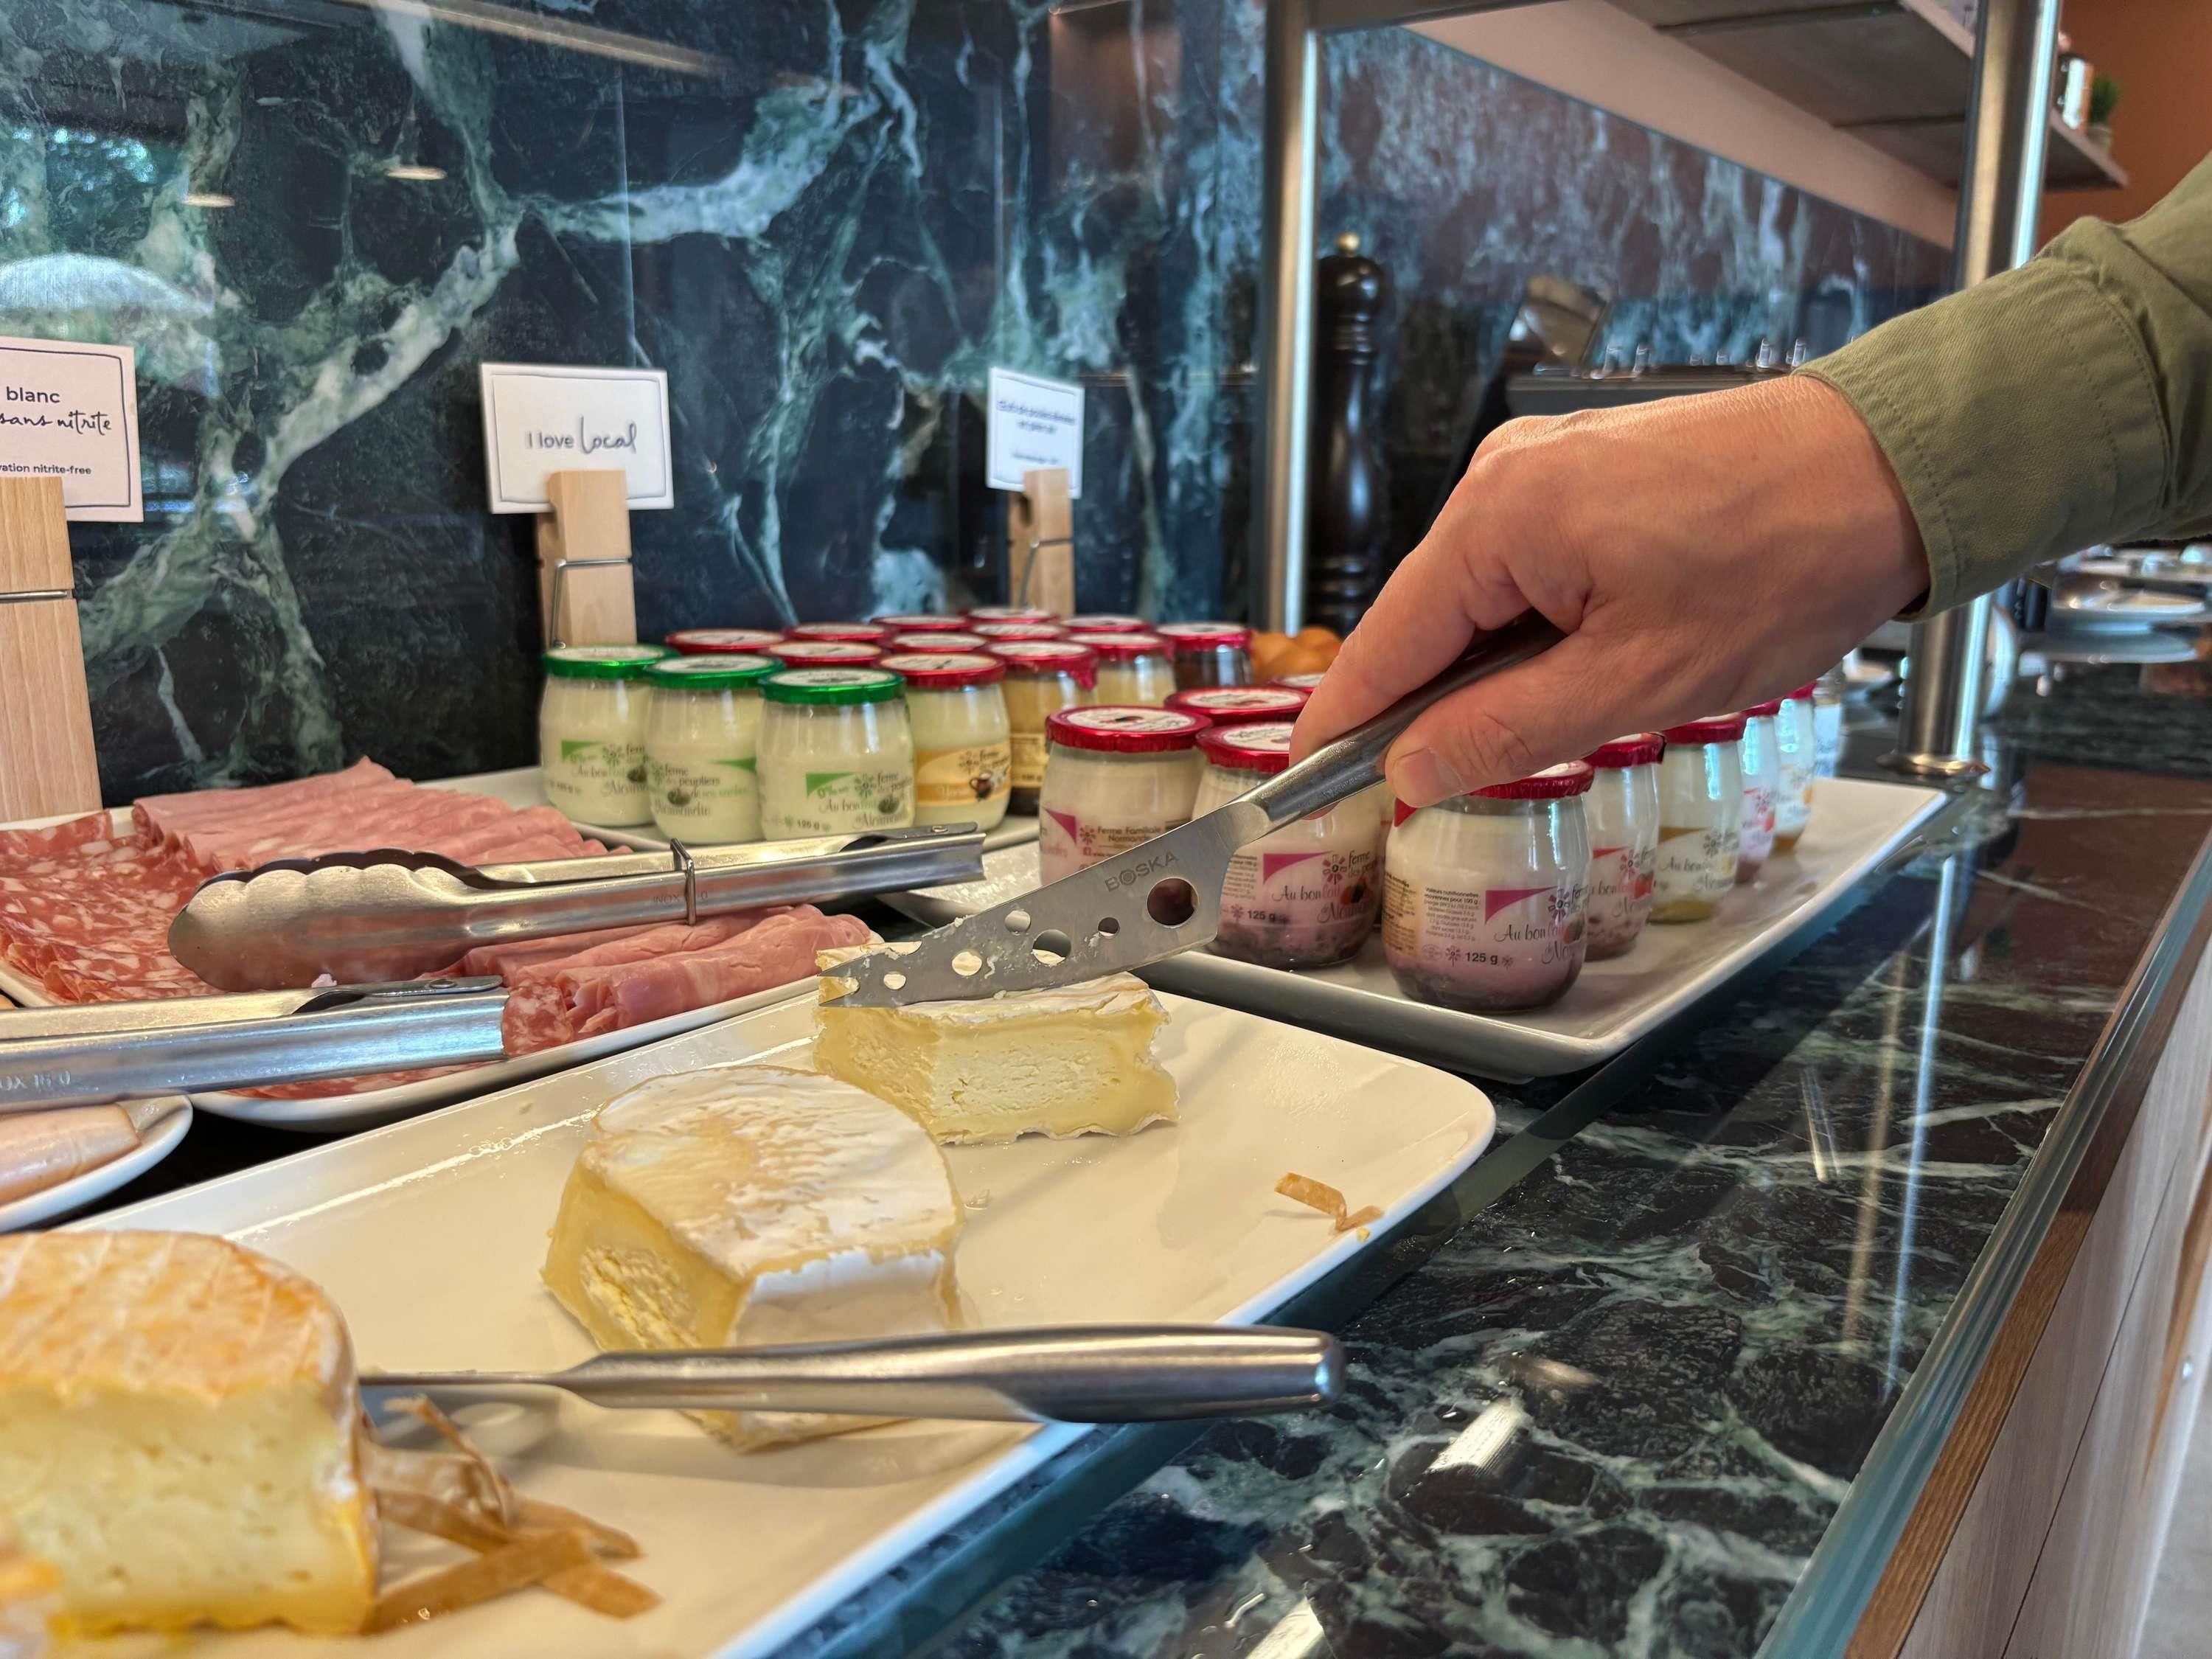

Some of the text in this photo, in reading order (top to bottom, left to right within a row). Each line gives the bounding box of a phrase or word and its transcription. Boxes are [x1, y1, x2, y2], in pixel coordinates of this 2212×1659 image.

[6, 386, 61, 405] blanc
[0, 409, 112, 436] sans nitrite
[539, 431, 574, 450] love
[33, 465, 92, 475] nitrite-free
[1098, 825, 1122, 835] Ferme
[1105, 850, 1180, 893] BOSKA
[1271, 885, 1298, 902] Au
[1301, 885, 1322, 900] bon
[1247, 909, 1266, 919] 125
[1493, 924, 1521, 942] Au
[1525, 924, 1546, 941] bon
[1466, 952, 1498, 965] 125 g
